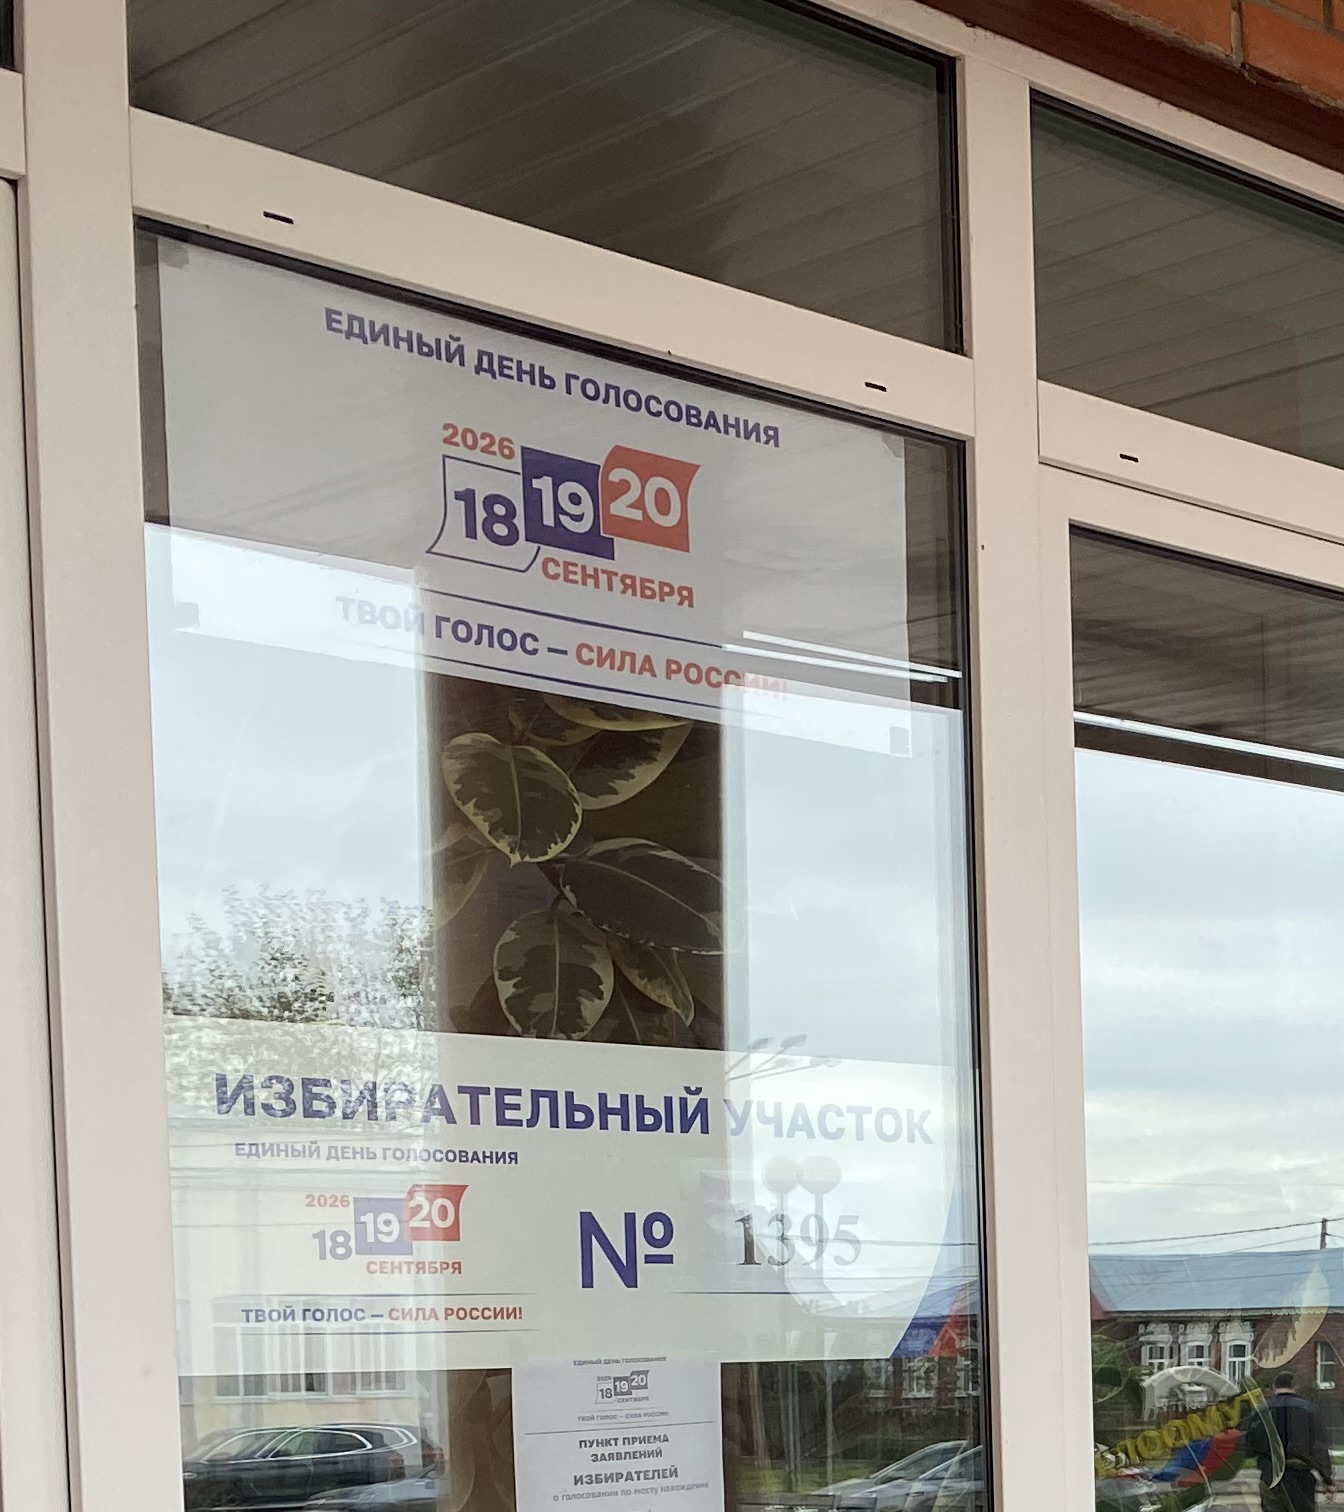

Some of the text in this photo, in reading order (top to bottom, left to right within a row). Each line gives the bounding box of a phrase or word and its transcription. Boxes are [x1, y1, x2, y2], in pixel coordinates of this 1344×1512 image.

[324, 307, 780, 448] ЕДИНЫЙ ДЕНЬ ГОЛОСОВАНИЯ
[442, 422, 516, 460] 2026
[454, 467, 682, 547] 18 19 20
[541, 556, 695, 609] СЕНТЯБРЯ
[336, 595, 424, 635] ТВОЙ
[435, 615, 539, 656] ГОЛОС
[575, 641, 657, 679] СИЛА
[215, 1072, 934, 1145] ИЗБИРАТЕЛЬНЫЙ УЧАСТОК
[234, 1140, 519, 1165] ЕДИНЫЙ ДЕНЬ ГОЛОСОВАНИЯ
[305, 1193, 351, 1208] 2026
[312, 1197, 455, 1261] 18 19 20
[579, 1211, 862, 1289] № 1395
[366, 1260, 462, 1275] СЕНТЯБРЯ
[241, 1305, 296, 1323] ТВОЙ
[302, 1308, 366, 1322] ГОЛОС
[388, 1307, 439, 1321] СИЛА
[444, 1306, 523, 1321] РОССИИ!
[599, 1375, 646, 1399] 18 19 20
[578, 1434, 669, 1448] ПУНКТ ПРИЕМА
[591, 1447, 663, 1462] ЗАЯВЛЕНИЙ
[573, 1465, 678, 1486] ИЗБИРАТЕЛЕЙ
[562, 1490, 618, 1501] голосовании
[634, 1487, 658, 1495] месту
